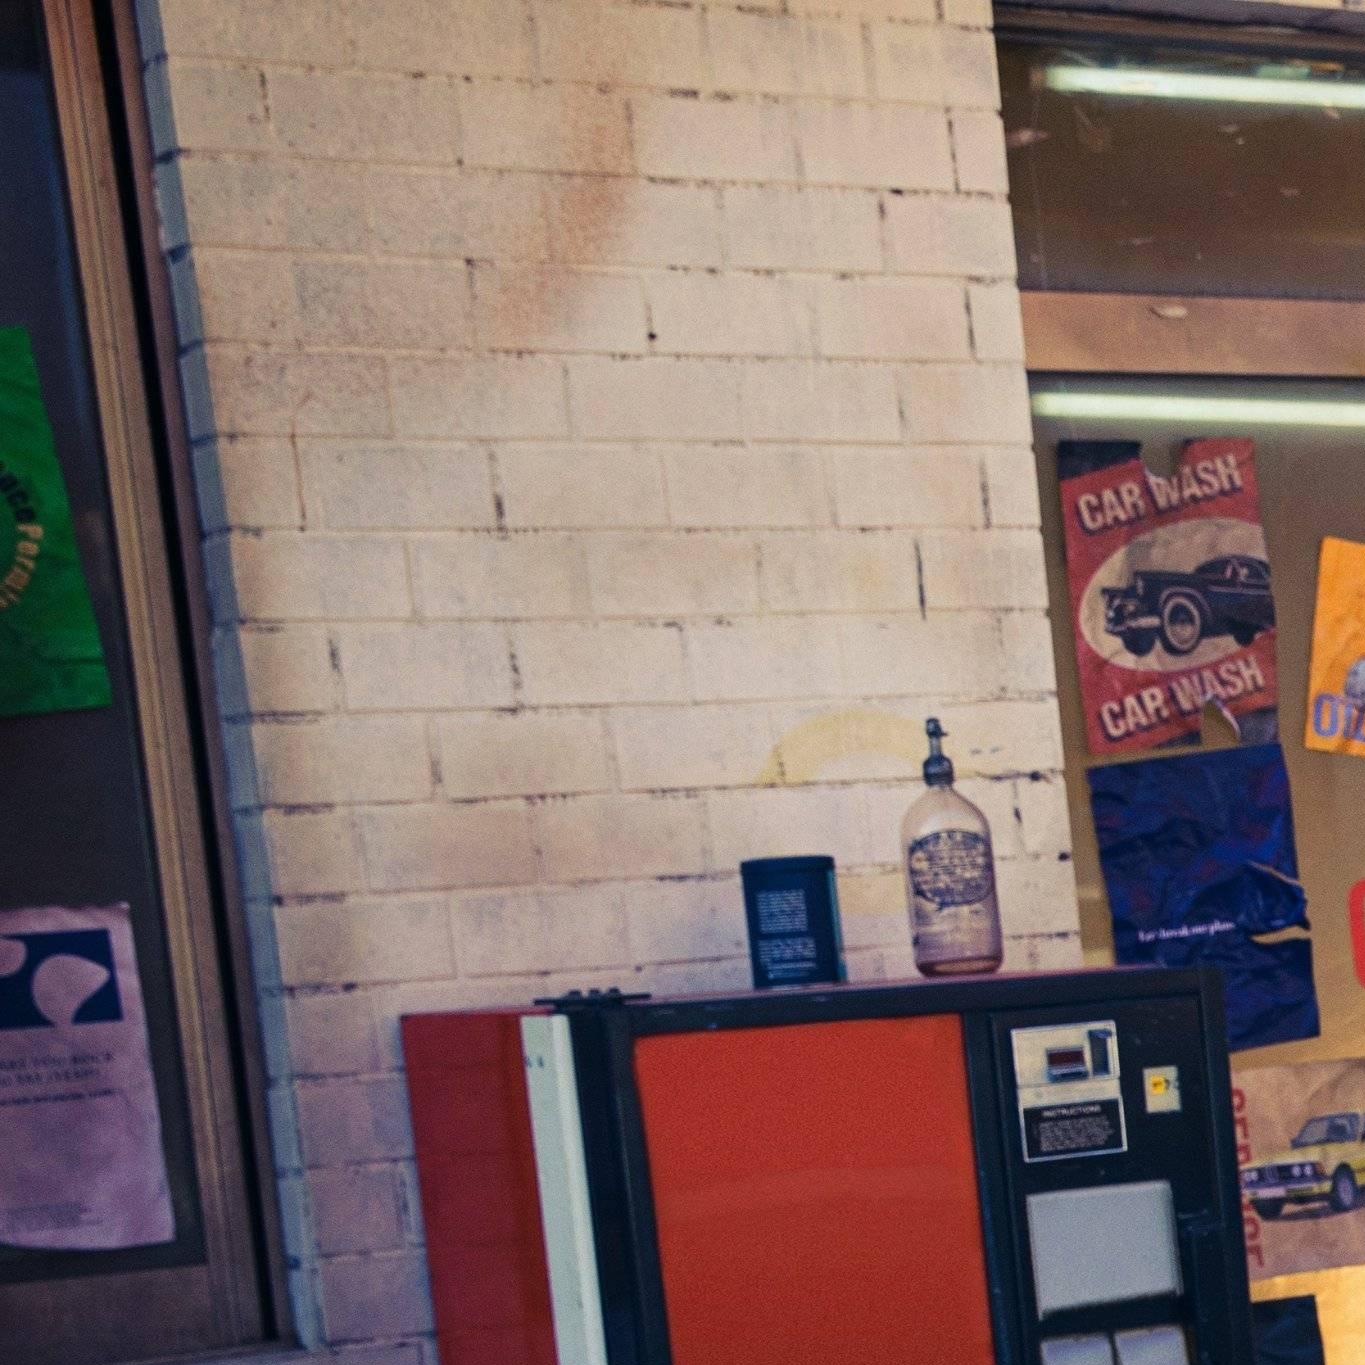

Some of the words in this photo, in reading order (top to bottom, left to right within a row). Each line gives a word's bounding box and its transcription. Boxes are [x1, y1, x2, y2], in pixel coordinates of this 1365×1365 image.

[1077, 482, 1147, 533] CAR
[1150, 454, 1243, 511] WASH
[1099, 686, 1170, 740] CAR
[1171, 656, 1266, 713] WASH
